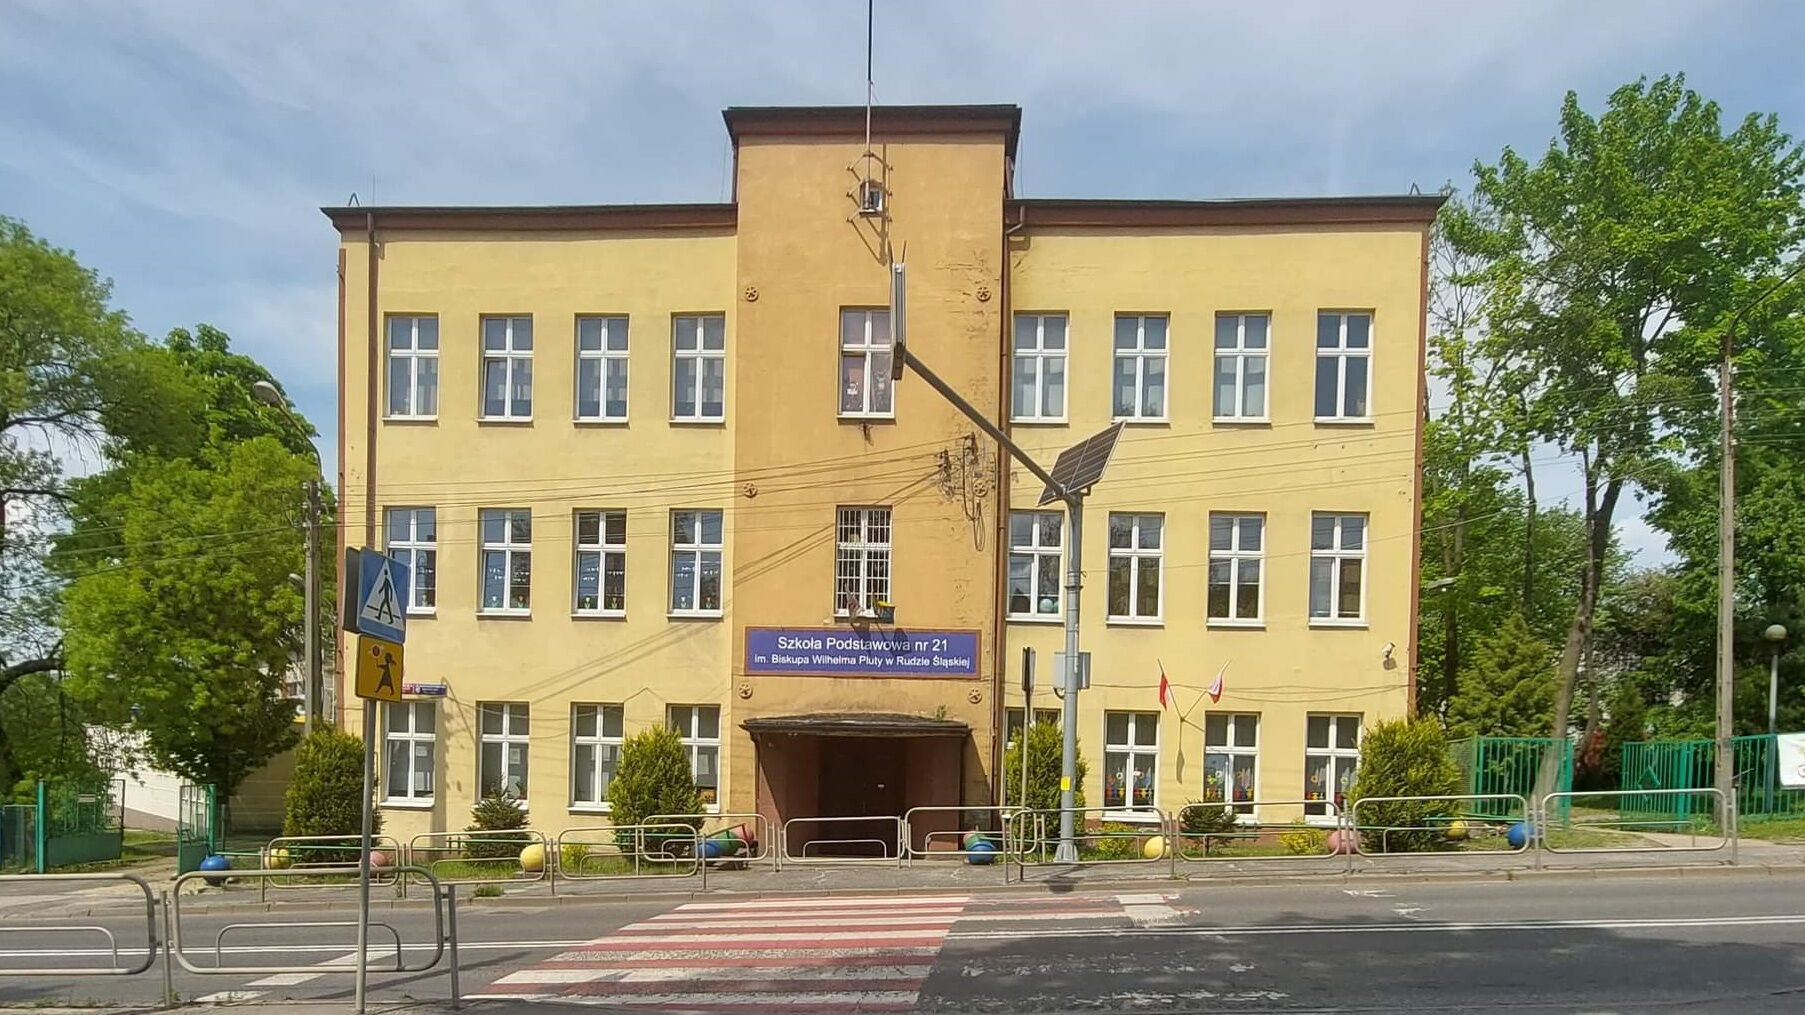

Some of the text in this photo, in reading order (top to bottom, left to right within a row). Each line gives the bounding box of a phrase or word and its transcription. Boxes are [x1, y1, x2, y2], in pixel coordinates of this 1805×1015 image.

[777, 636, 948, 652] Szkoła Podstawowa nr 21
[771, 654, 809, 667] Biskupa
[812, 654, 856, 665] Wilhelma
[858, 655, 883, 668] Pluty
[885, 658, 895, 666] w
[896, 656, 930, 665] Rudzie
[932, 654, 971, 669] Śląskiej
